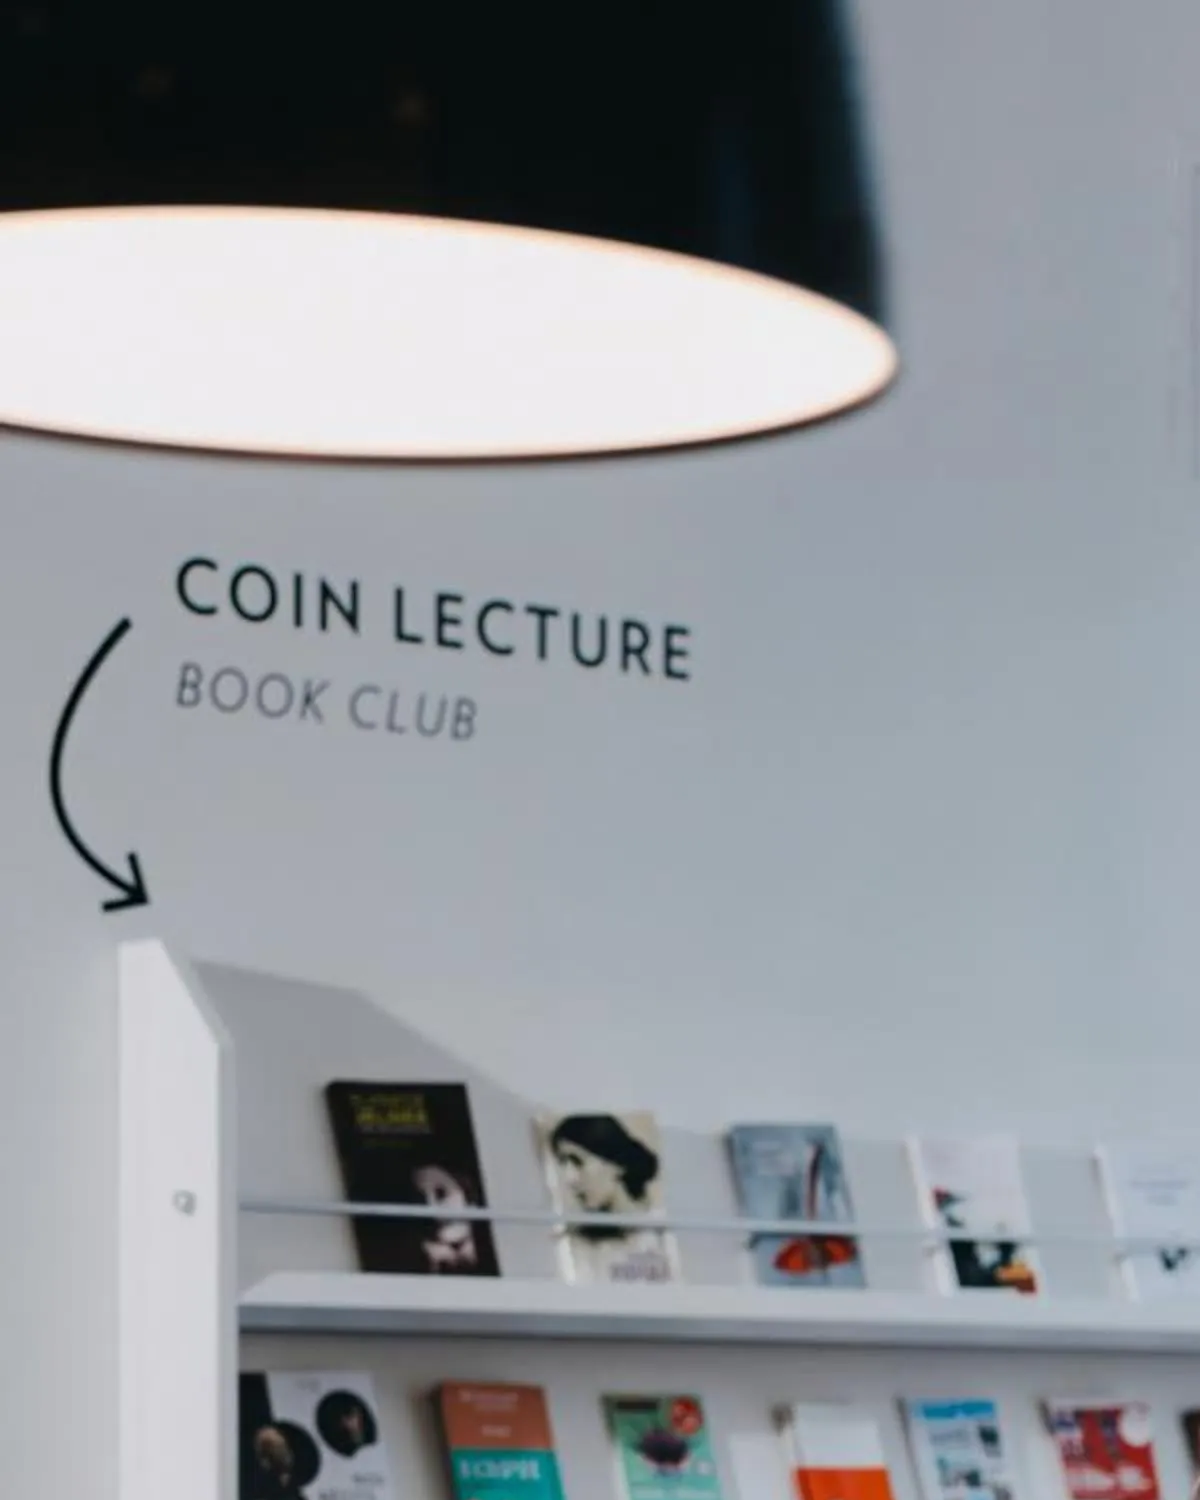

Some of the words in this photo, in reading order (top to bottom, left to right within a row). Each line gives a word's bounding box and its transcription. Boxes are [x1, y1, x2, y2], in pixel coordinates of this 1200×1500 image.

[174, 556, 361, 635] COIN
[393, 585, 693, 682] LECTURE
[176, 662, 329, 724] BOOK
[348, 685, 479, 742] CLUB
